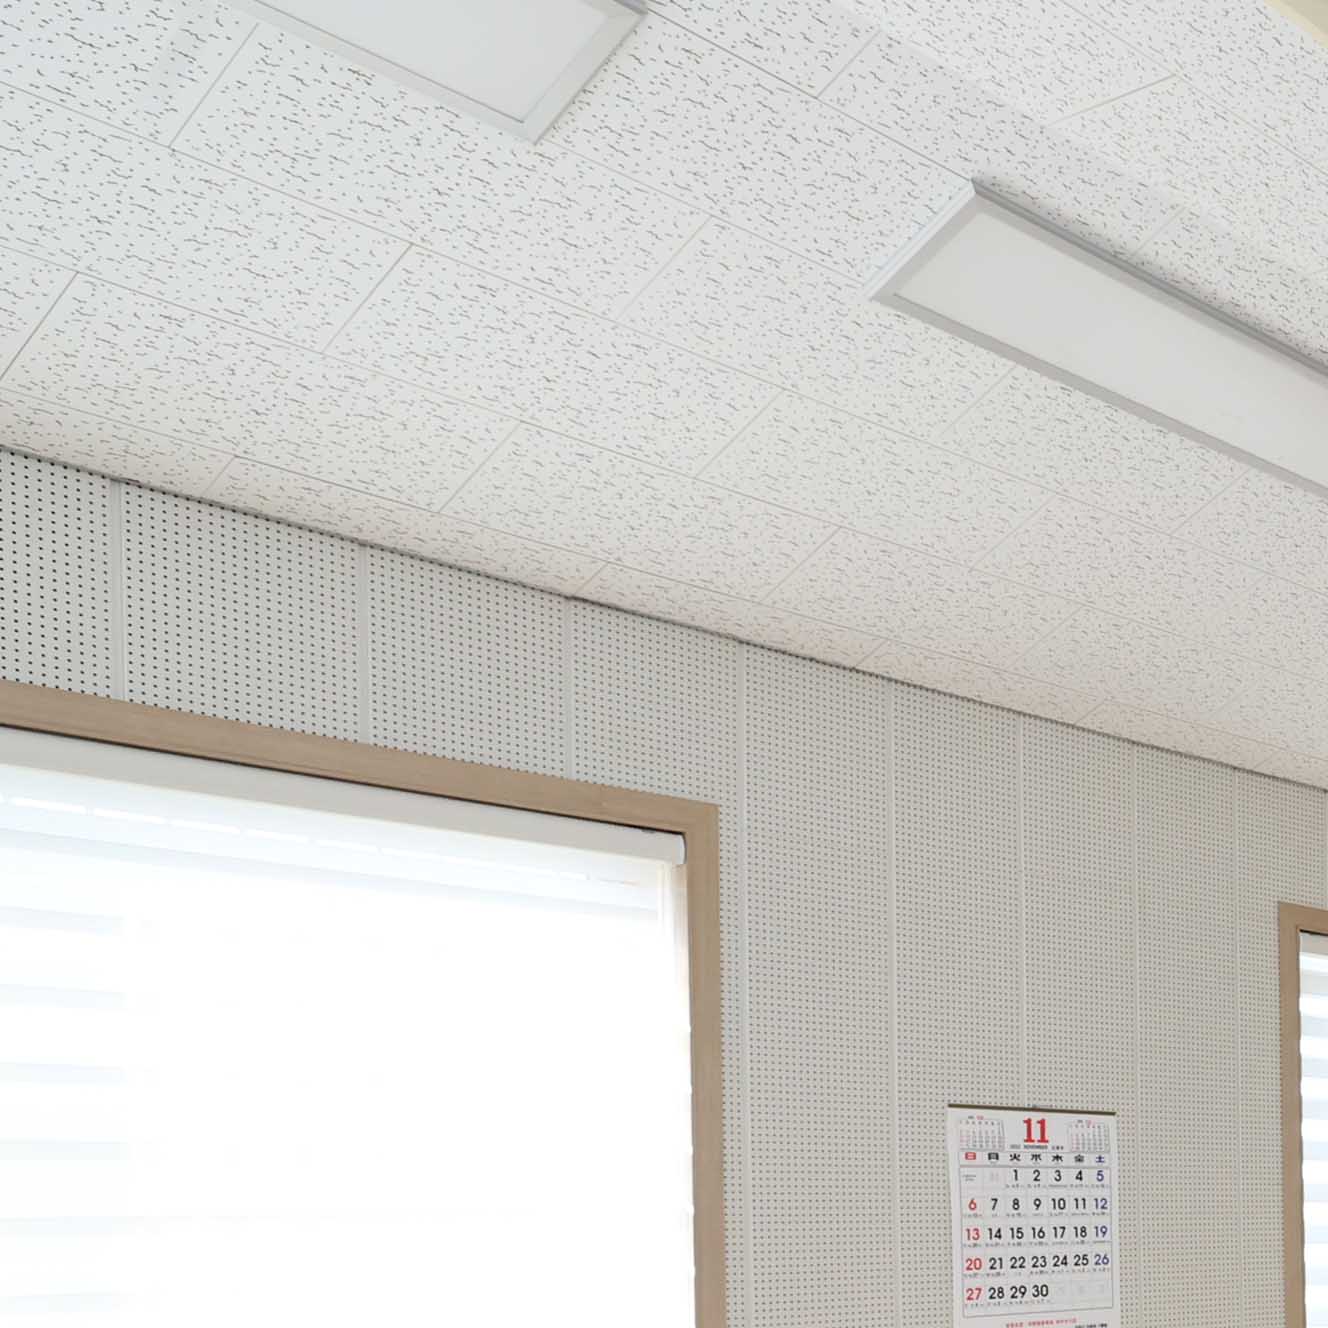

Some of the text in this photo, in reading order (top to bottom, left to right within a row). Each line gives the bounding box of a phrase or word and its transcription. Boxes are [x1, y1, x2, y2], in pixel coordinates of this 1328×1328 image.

[1023, 1118, 1049, 1143] 11
[1009, 1153, 1021, 1161] 火
[1095, 1155, 1104, 1163] 土
[1013, 1169, 1104, 1182] 1 2 3 4 5
[968, 1198, 1108, 1210] 6 7 8 9 10 11 12
[966, 1226, 1108, 1241] 13 14 15 16 17 18 19
[966, 1254, 1110, 1270] 20 21 22 23 24 25 26
[966, 1284, 1049, 1300] 27 28 29 30
